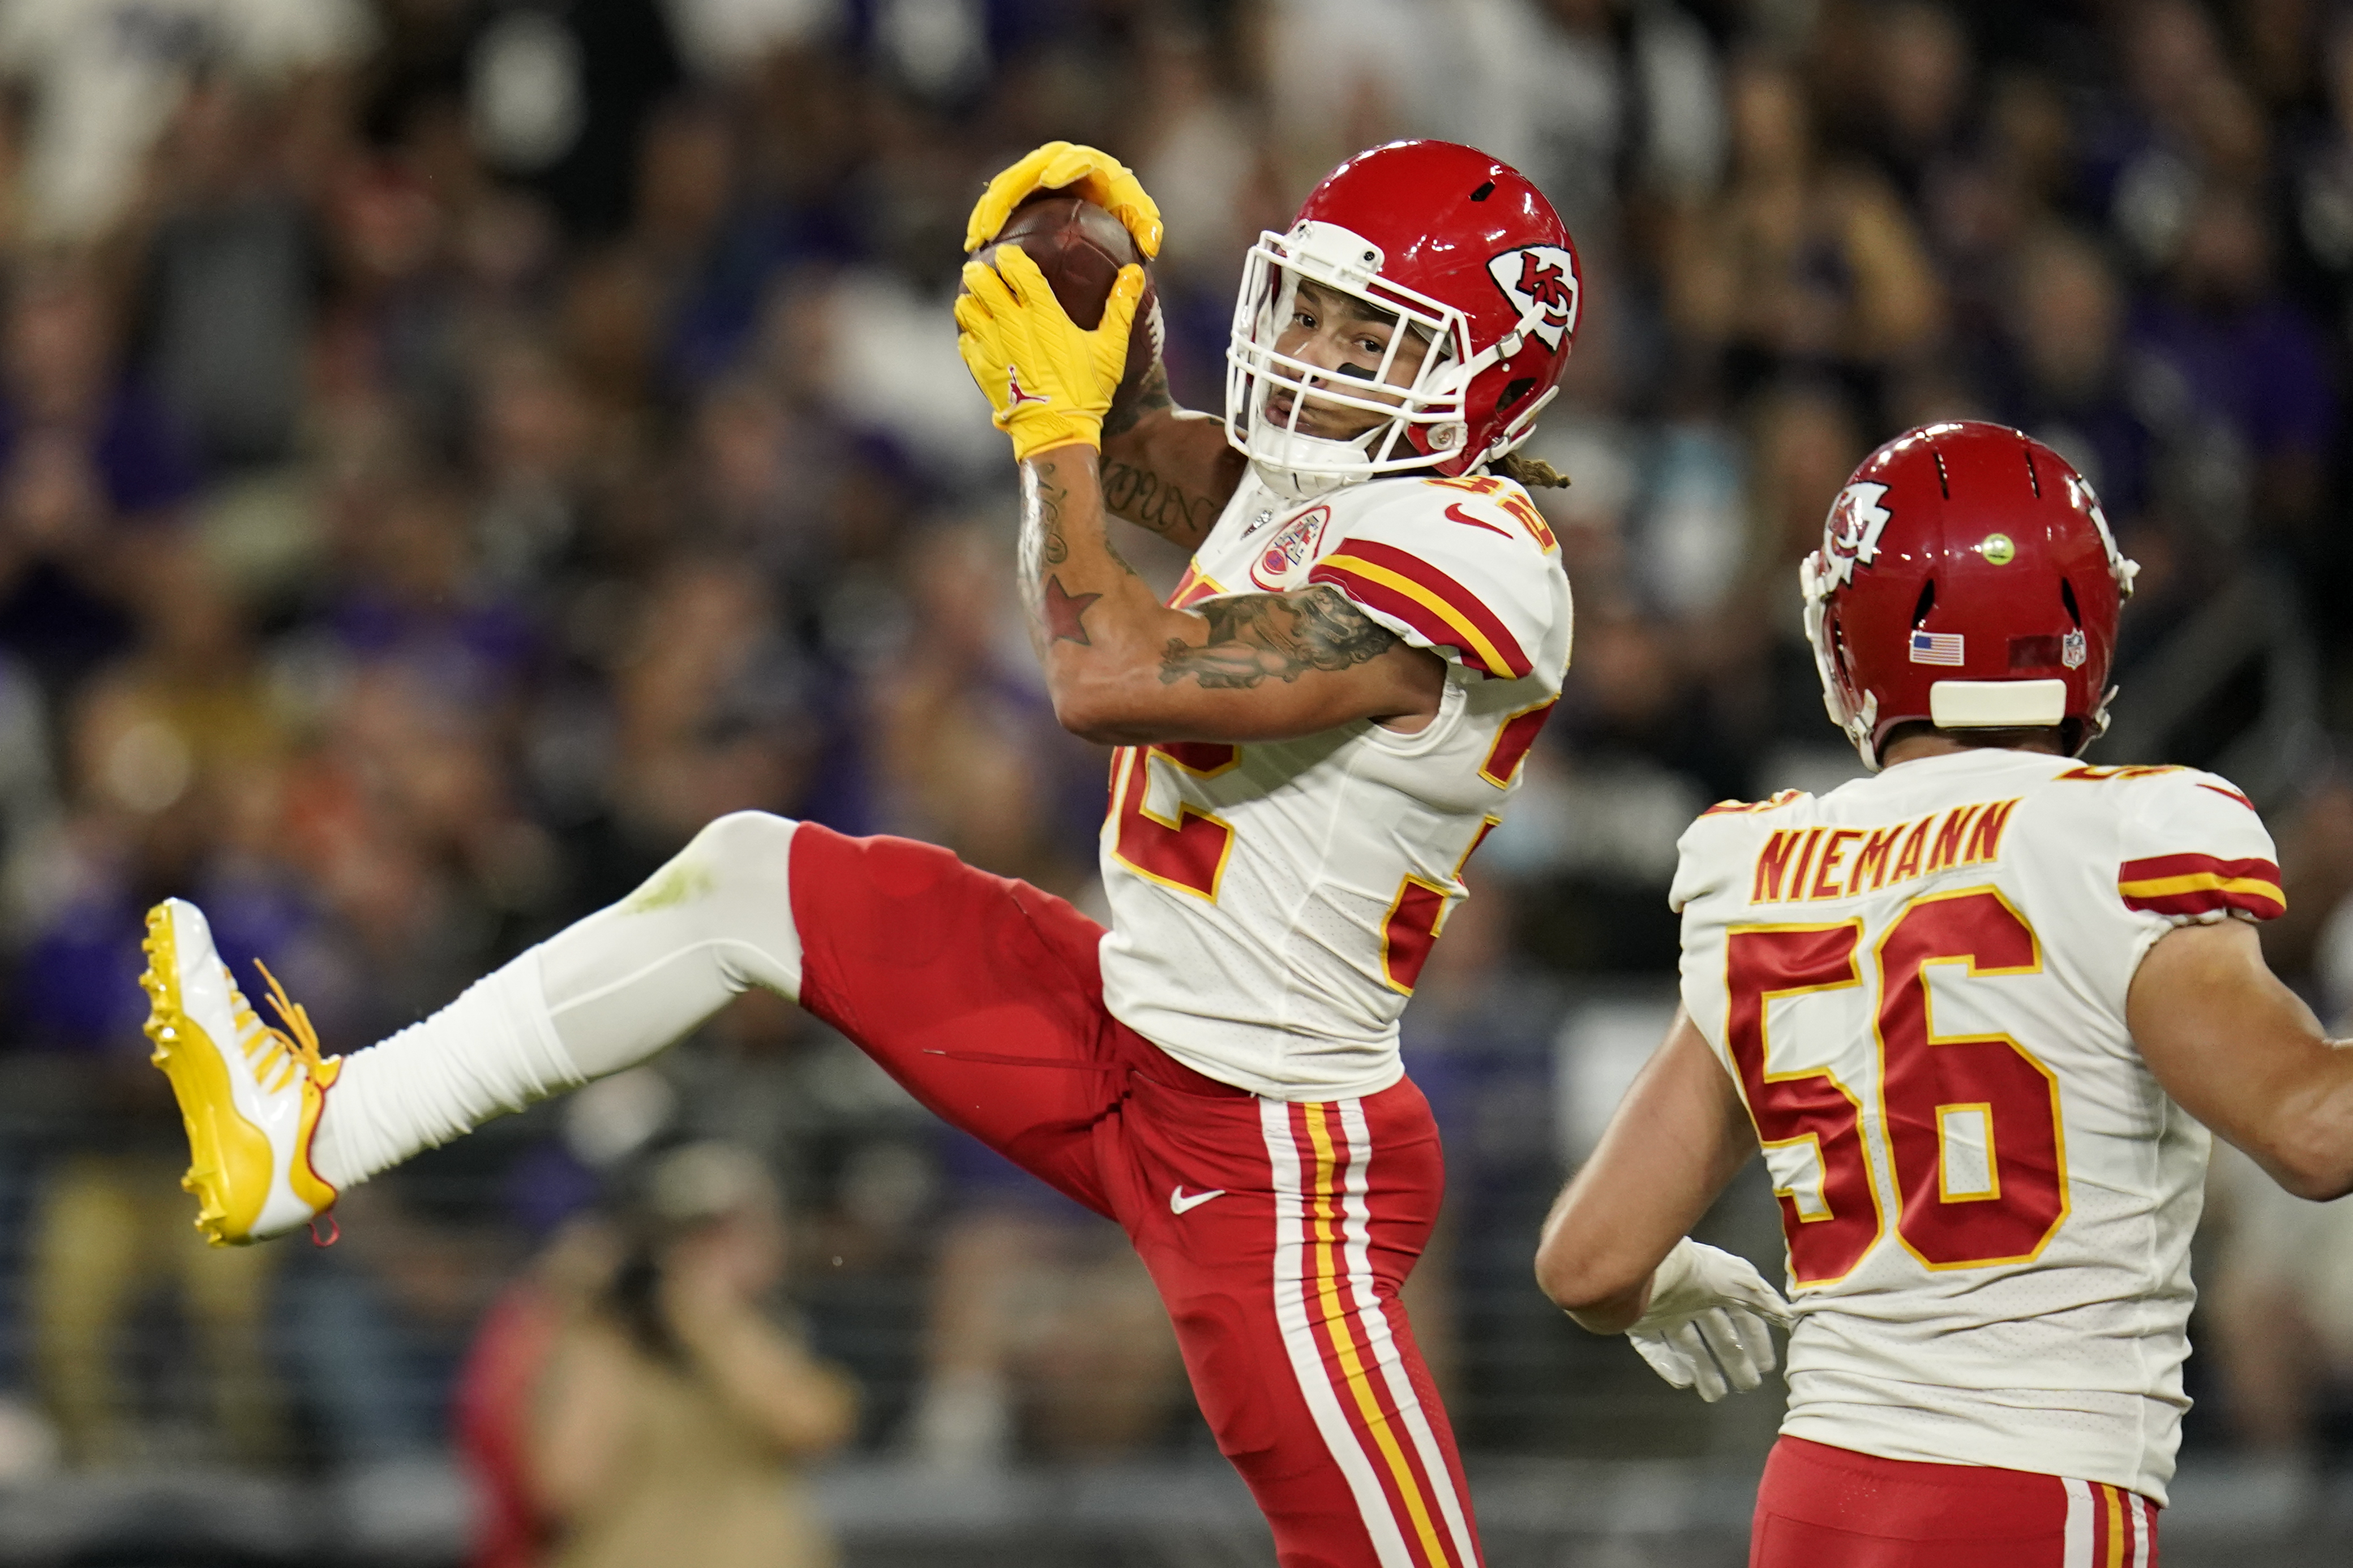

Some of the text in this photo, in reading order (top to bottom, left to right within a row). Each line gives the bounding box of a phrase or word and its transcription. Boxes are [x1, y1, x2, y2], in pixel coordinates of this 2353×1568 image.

[1515, 251, 1573, 327] KC
[1421, 474, 1561, 556] 32
[1750, 796, 2026, 905] NIEMANN
[1724, 884, 2072, 1290] 56
